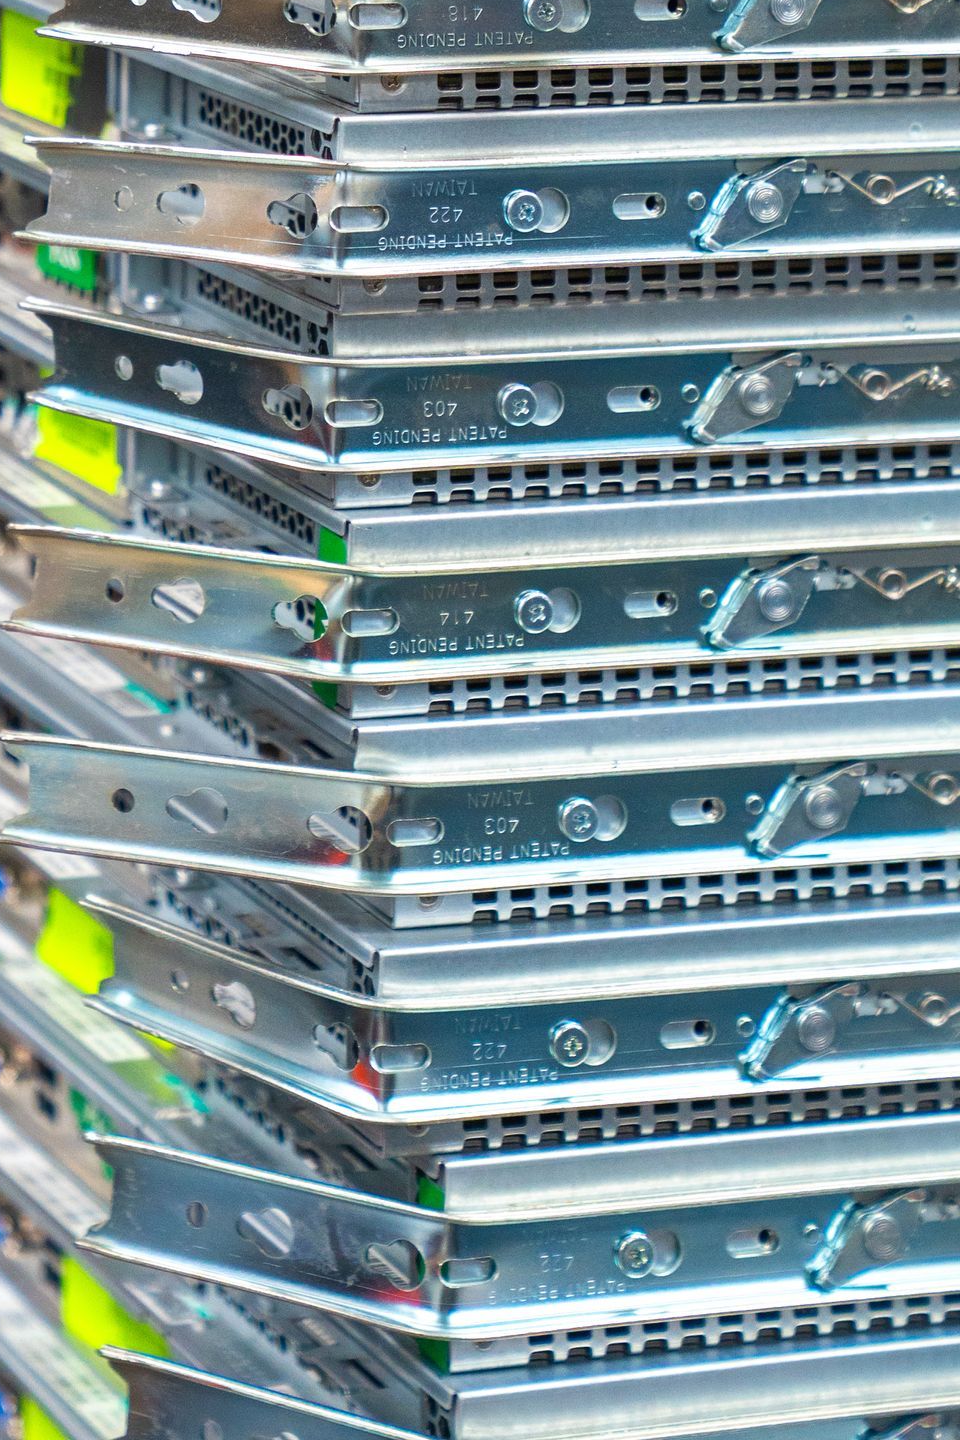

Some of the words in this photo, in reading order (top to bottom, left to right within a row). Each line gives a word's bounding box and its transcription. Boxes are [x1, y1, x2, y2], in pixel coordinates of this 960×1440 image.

[448, 5, 483, 21] 418
[397, 33, 466, 48] PENDING
[475, 31, 533, 45] PATENT
[411, 178, 478, 196] TAIWAN
[429, 206, 463, 222] 422
[378, 234, 446, 250] PENDING
[454, 232, 512, 248] PATENT
[406, 373, 472, 391] TAIWAN
[423, 400, 457, 417] 403
[372, 428, 440, 445] PENDING
[448, 425, 507, 442] PATENT
[440, 609, 474, 625] 414
[389, 637, 457, 654] PENDING
[466, 634, 524, 650] PATENT
[468, 789, 534, 808] TAIWAN
[485, 817, 519, 834] 403
[433, 845, 502, 864] PENDING
[511, 842, 569, 859] PATENT
[472, 1042, 507, 1059] 422
[499, 1068, 558, 1085] PATENT
[488, 1285, 558, 1304] PENDIG
